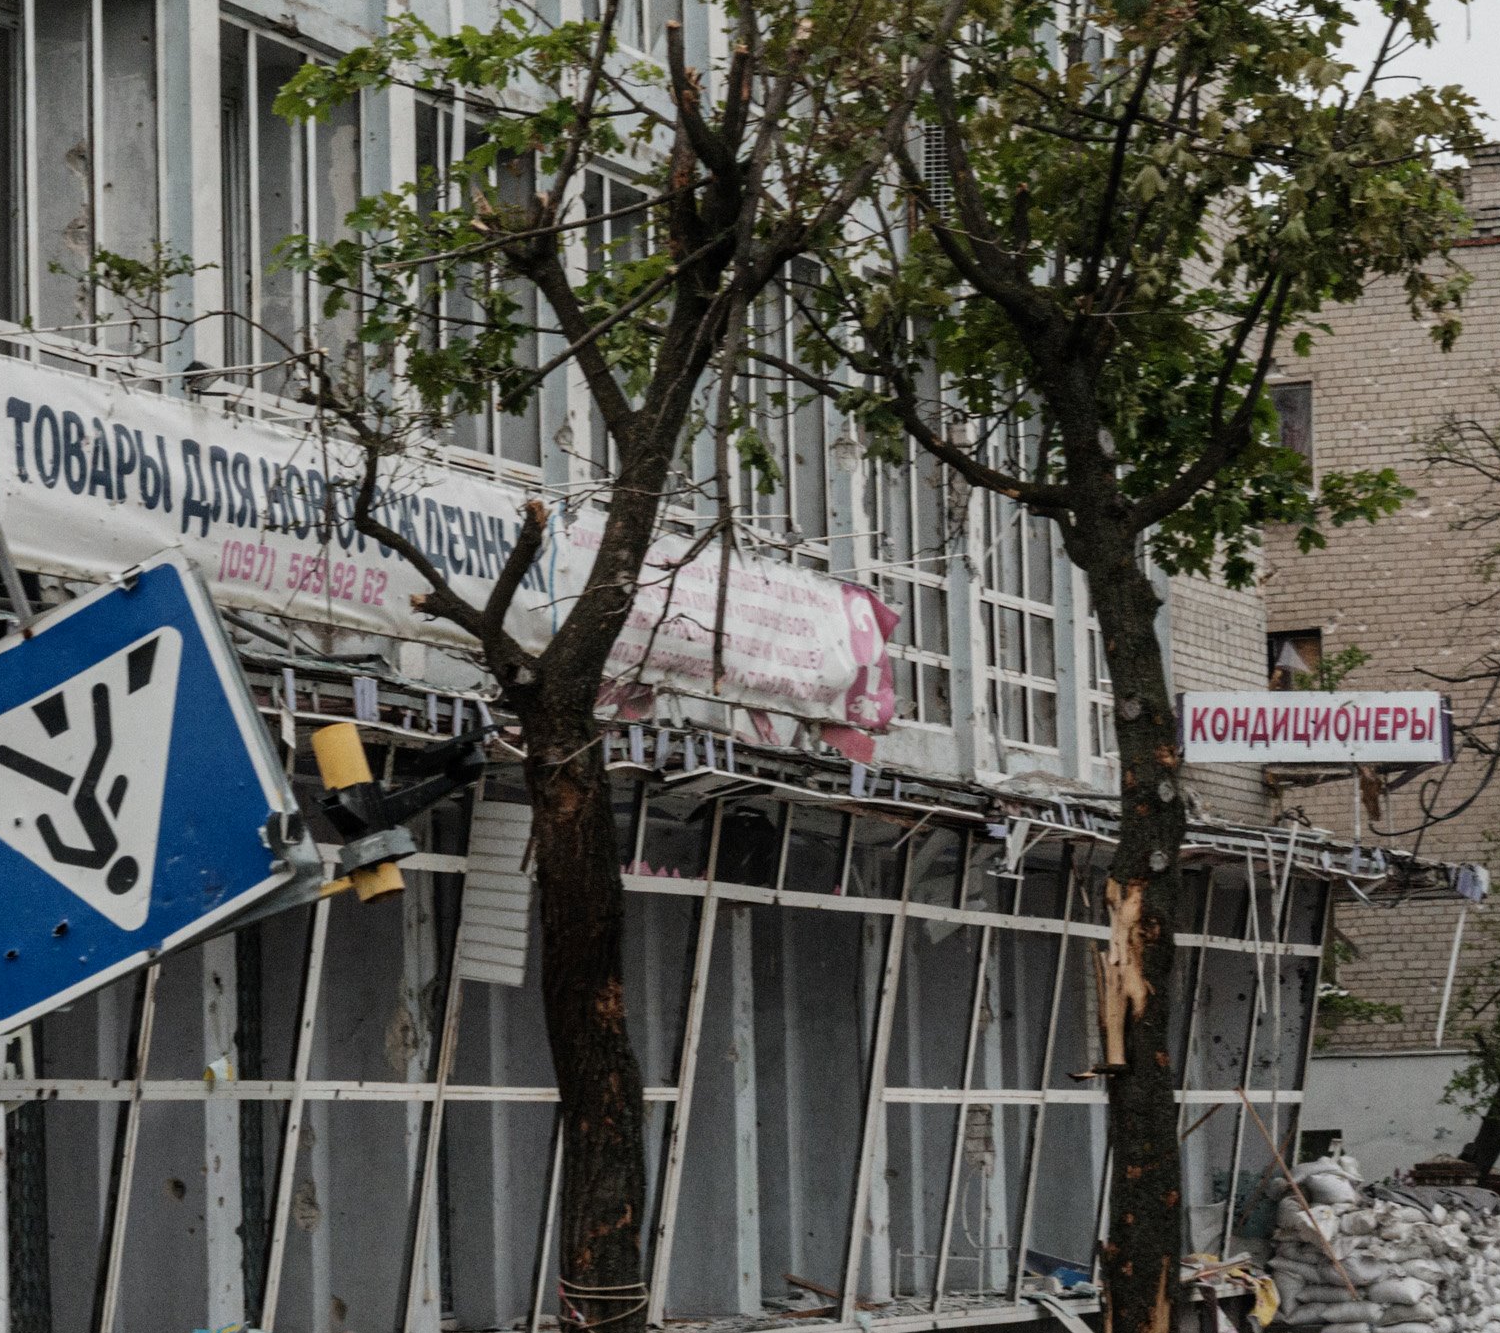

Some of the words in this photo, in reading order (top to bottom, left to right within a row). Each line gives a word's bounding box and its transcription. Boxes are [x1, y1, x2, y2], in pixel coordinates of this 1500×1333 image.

[6, 396, 173, 514] ТОВАРЫ
[180, 438, 258, 539] ДЛЯ
[219, 539, 277, 592] (097)
[330, 561, 358, 602] 92
[362, 567, 389, 607] 62
[1190, 706, 1435, 748] КОНДИЦИОНЕРЫ
